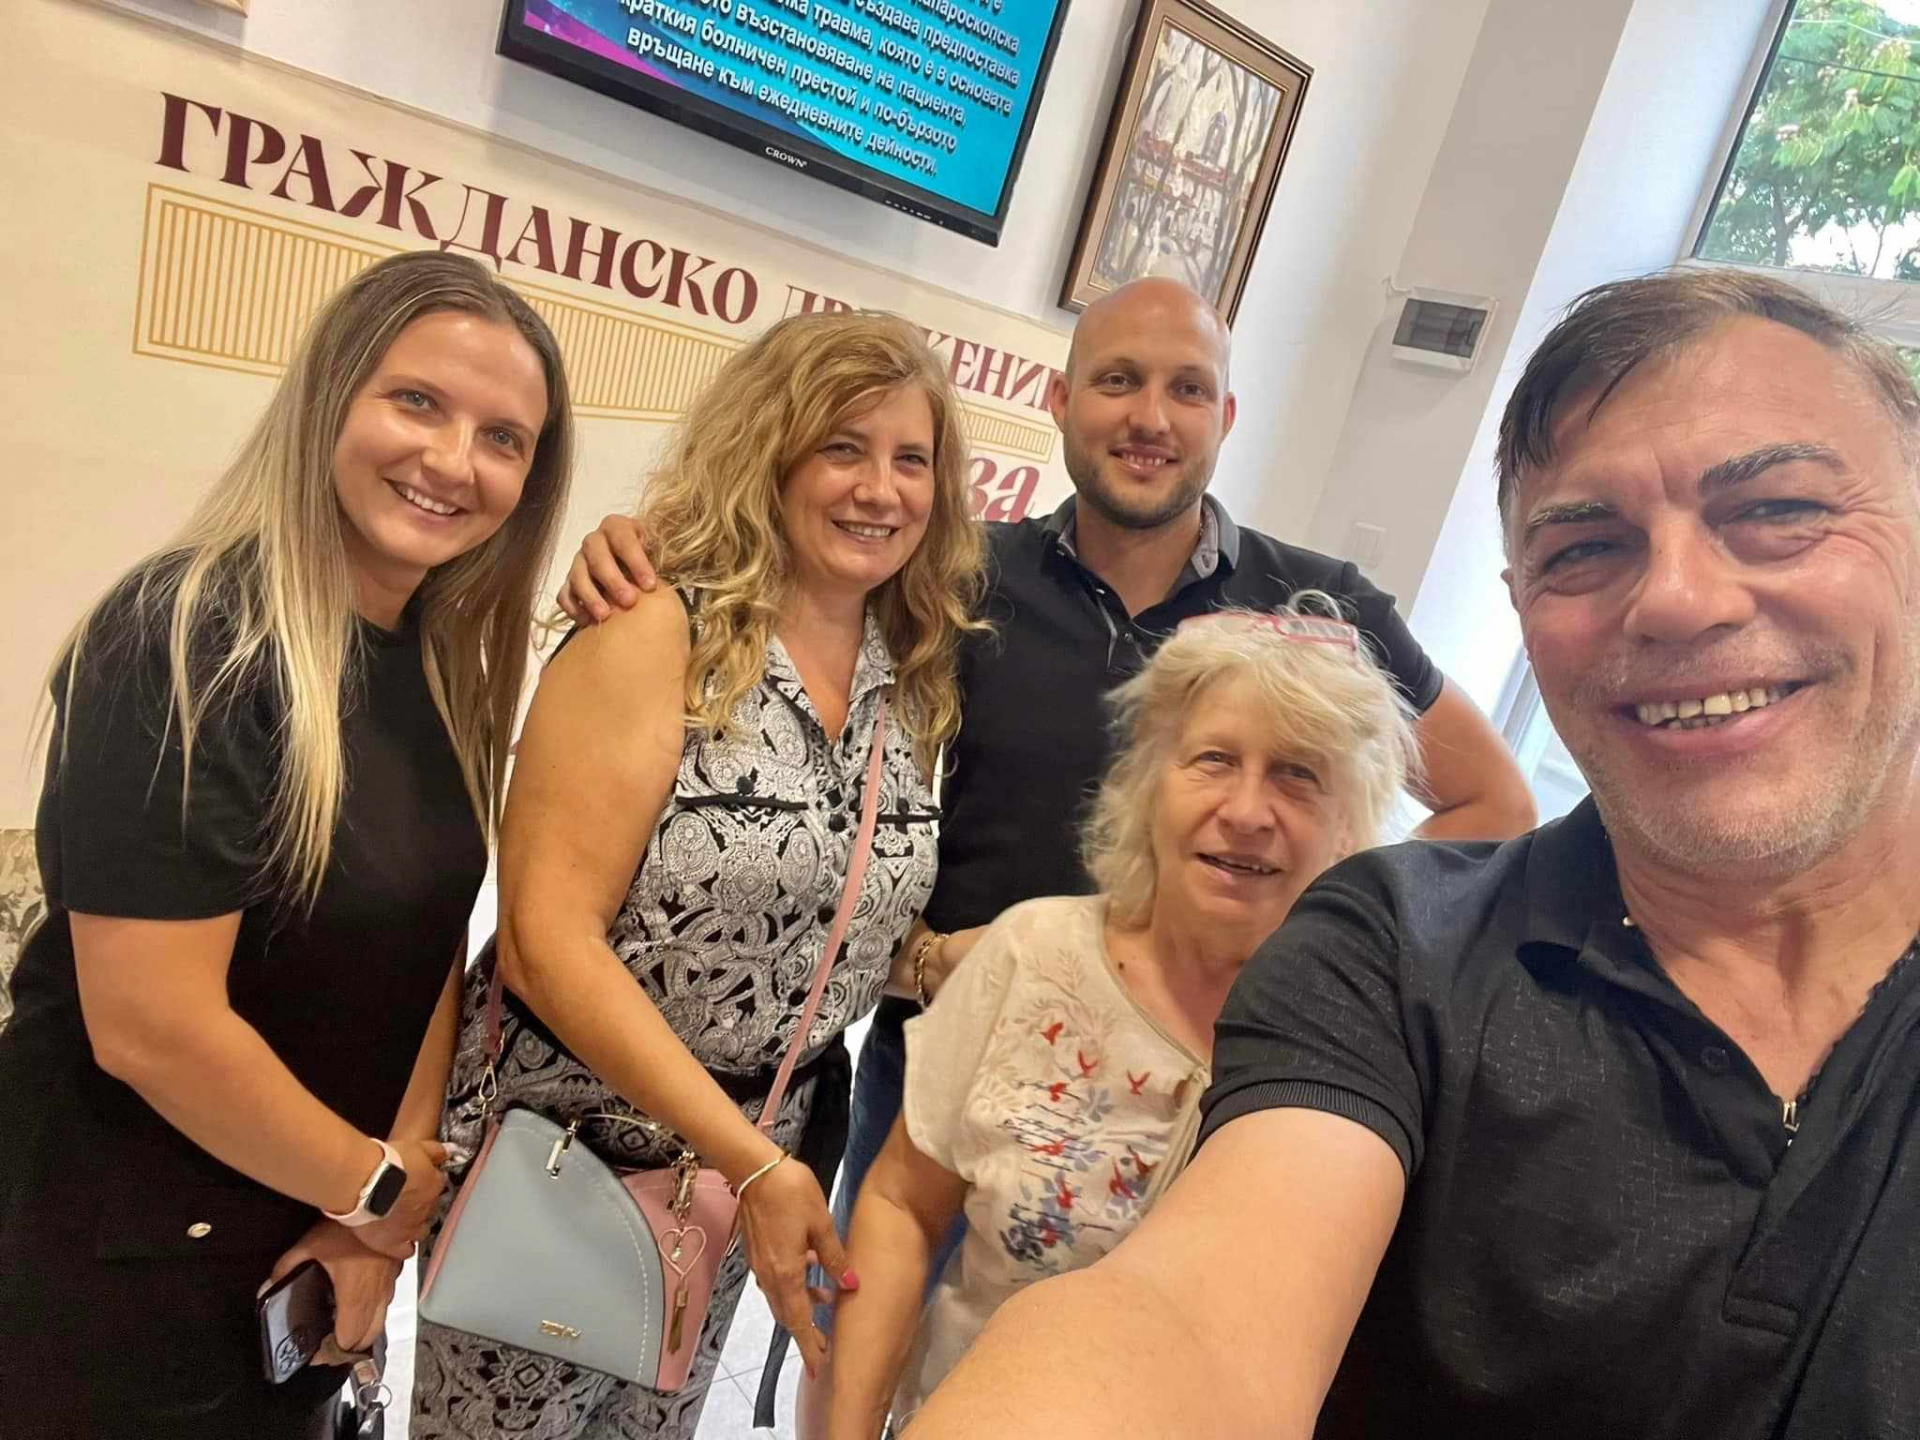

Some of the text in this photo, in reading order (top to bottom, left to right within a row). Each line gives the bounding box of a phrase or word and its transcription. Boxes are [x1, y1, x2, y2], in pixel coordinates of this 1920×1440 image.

[701, 18, 787, 74] болничен
[791, 64, 858, 105] престой
[860, 97, 871, 112] и
[874, 101, 958, 150] по-бързото
[736, 2, 873, 79] възстановяване
[876, 71, 894, 89] на
[898, 80, 966, 126] пациента,
[814, 3, 874, 50] травма,
[879, 35, 921, 69] която
[925, 60, 934, 75] е
[937, 65, 946, 81] в
[950, 73, 1013, 112] основата
[919, 0, 1020, 52] пароскопска
[923, 25, 1020, 84] предпоставка
[628, 27, 937, 176] връщане към ежедневните дейности.
[154, 91, 759, 325] ГРАЖДАНСКО
